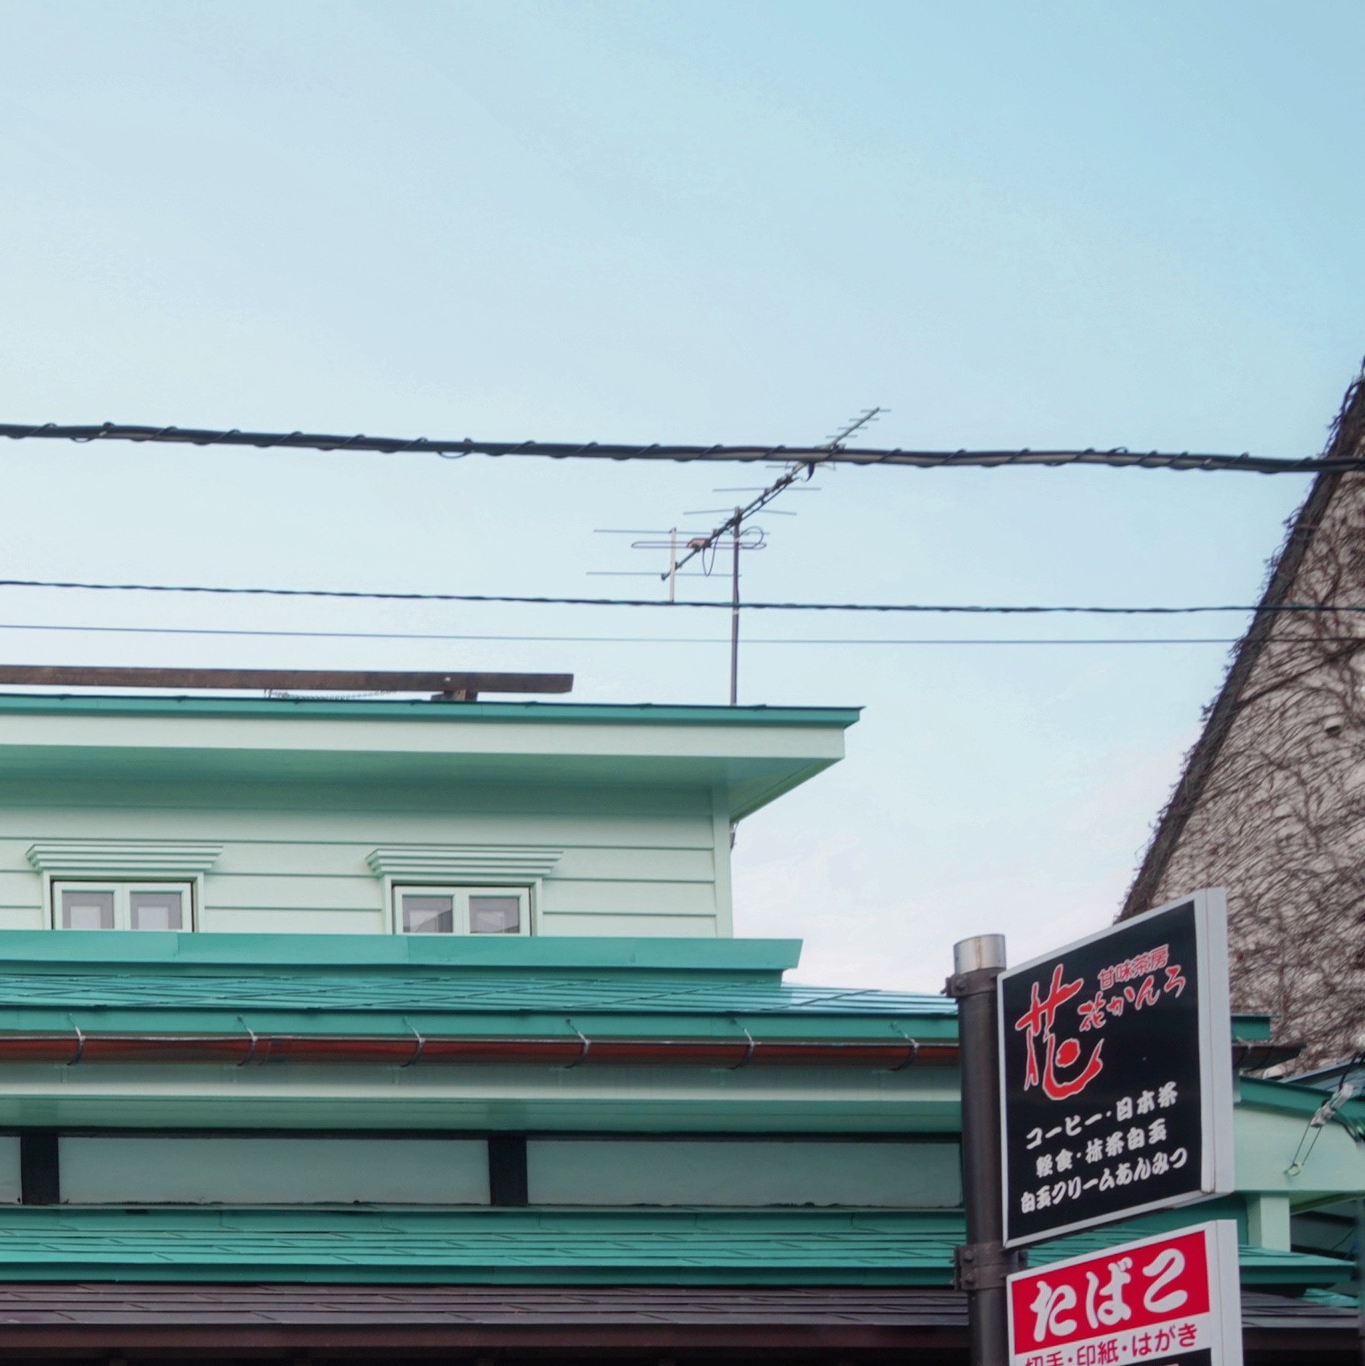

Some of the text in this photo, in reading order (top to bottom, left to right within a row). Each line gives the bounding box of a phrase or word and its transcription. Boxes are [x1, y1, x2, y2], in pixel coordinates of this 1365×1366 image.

[1077, 964, 1187, 1033] 花かんろ
[1098, 944, 1169, 991] 甘味茶房
[1025, 1081, 1179, 1150] コーヒー・日本茶
[1035, 1118, 1168, 1178] 軽食・抹茶白玉
[1020, 1147, 1188, 1214] 白玉クリームあんみつ
[1029, 1247, 1189, 1344] たばこ
